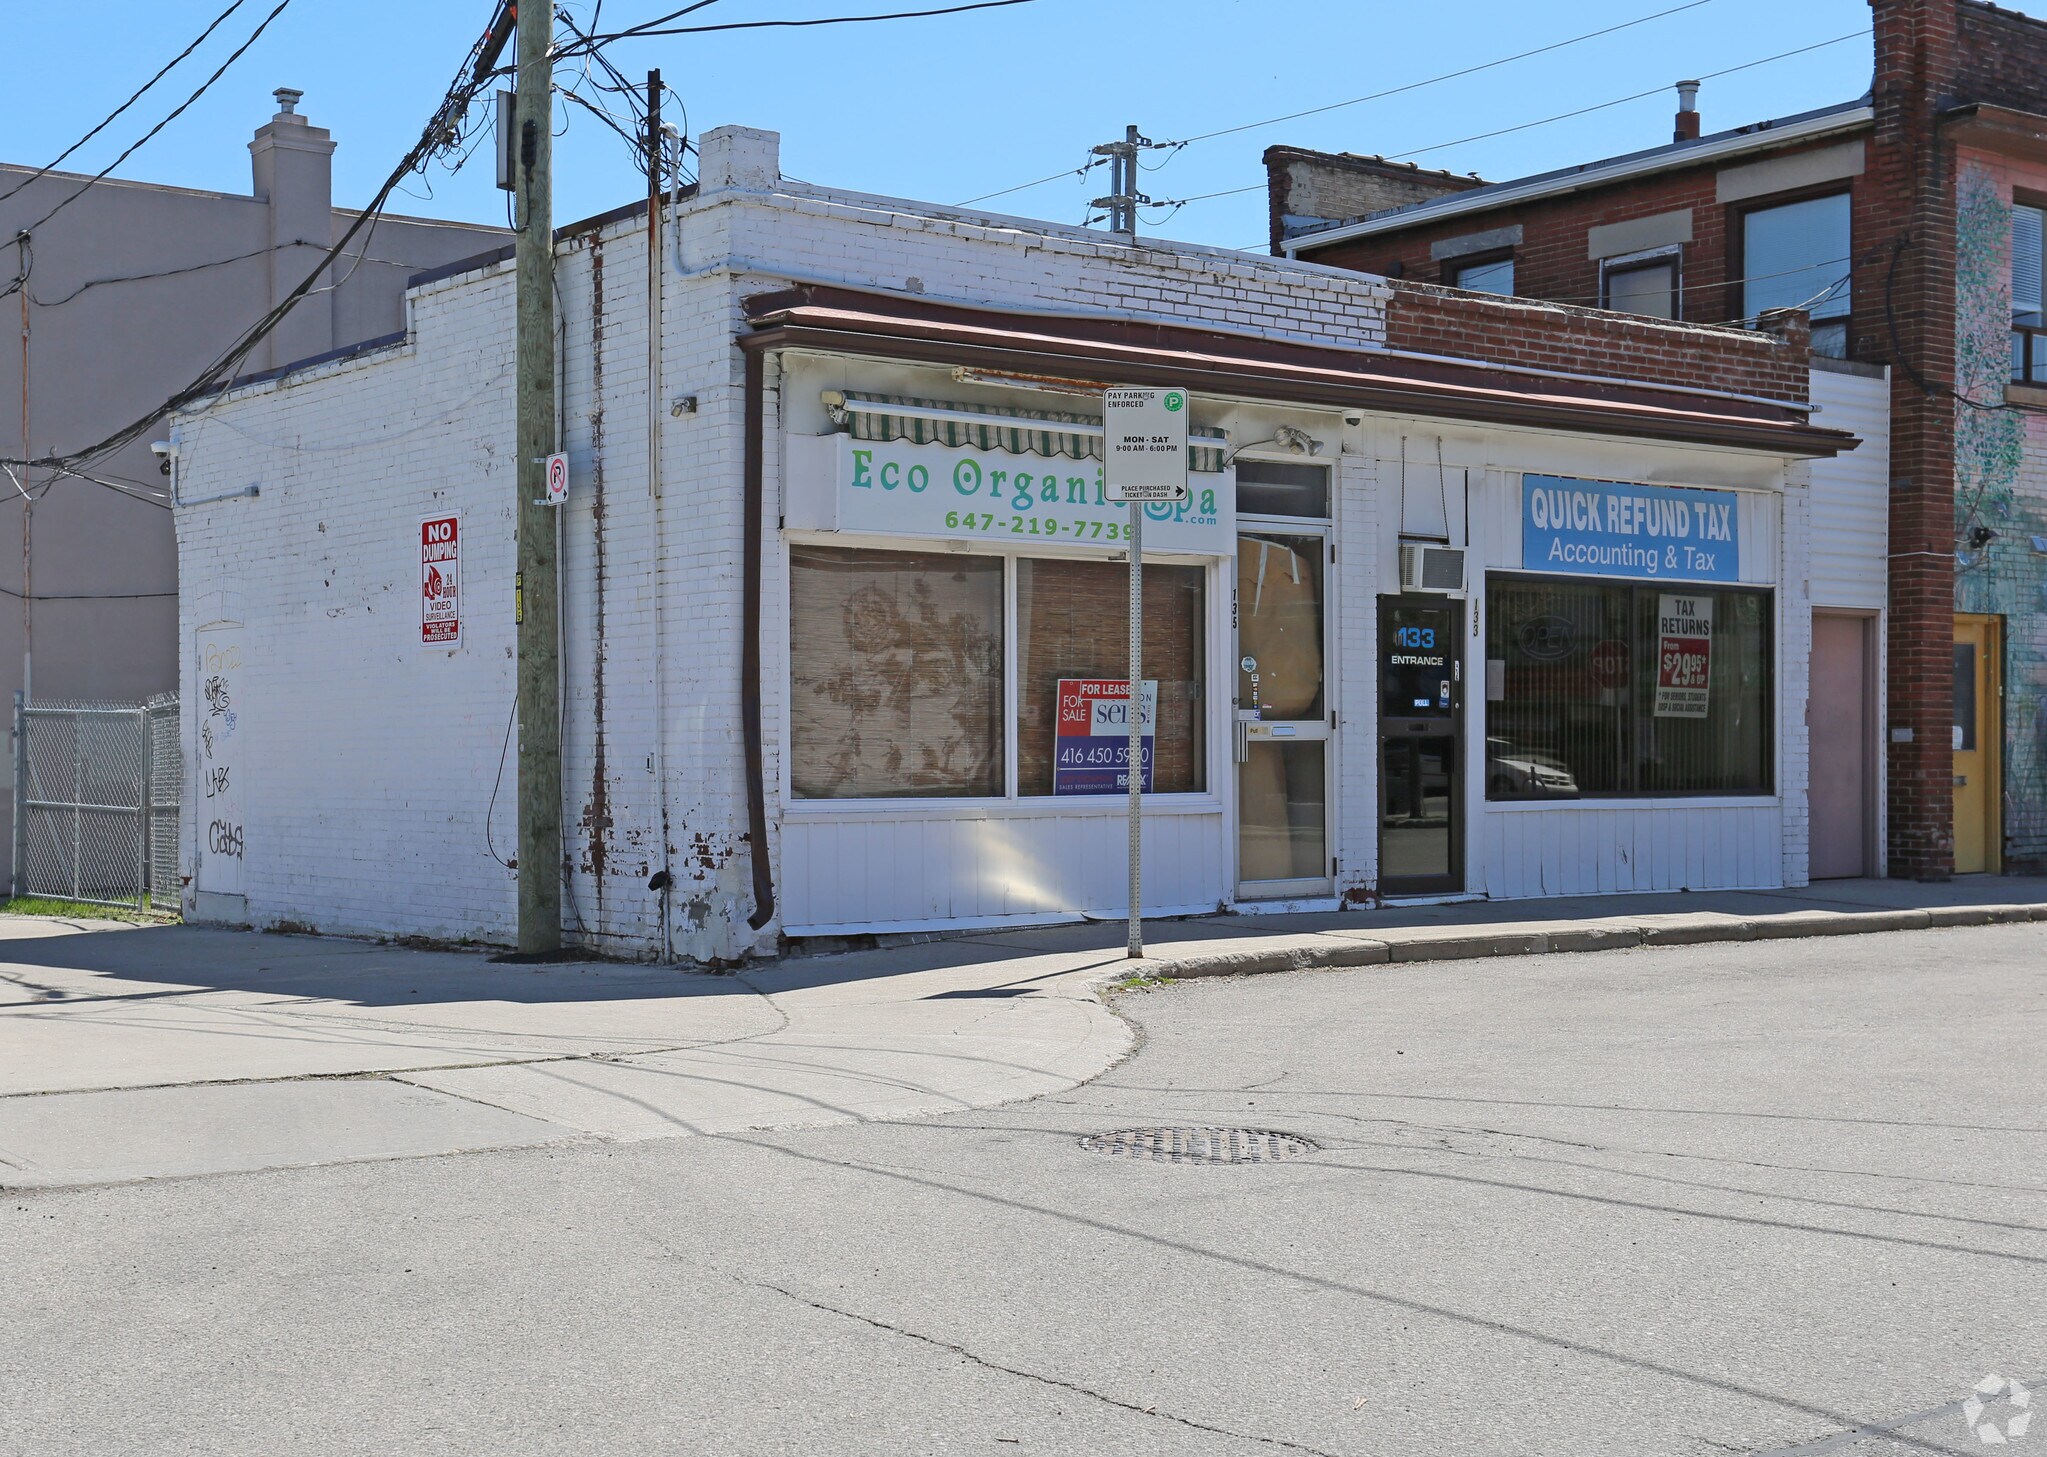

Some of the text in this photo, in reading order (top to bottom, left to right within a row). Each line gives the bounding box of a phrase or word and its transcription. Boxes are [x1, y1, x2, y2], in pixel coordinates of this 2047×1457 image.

[851, 449, 929, 493] Eco
[953, 458, 1128, 510] Organi
[1531, 487, 1732, 542] QUICK REFUND TAX
[428, 522, 452, 543] NO
[423, 540, 457, 562] DUMPING
[1548, 537, 1716, 574] Accounting & Tax
[446, 573, 453, 586] 24
[442, 585, 456, 599] HOUR
[429, 600, 452, 611] VIDEO
[1675, 599, 1695, 616] TAX
[425, 610, 456, 622] SURVEILLANCE
[425, 621, 456, 630] VIOLATORS
[1661, 617, 1709, 636] RETURNS
[423, 631, 458, 642] PROSECUTED
[1397, 626, 1436, 649] 133
[1663, 640, 1679, 650] From
[1391, 655, 1444, 666] ENTRANCE
[1081, 683, 1131, 695] FOR LEASE
[1063, 695, 1084, 708] FOR
[1062, 708, 1086, 722] SALE
[1060, 747, 1149, 764] 416 450 590
